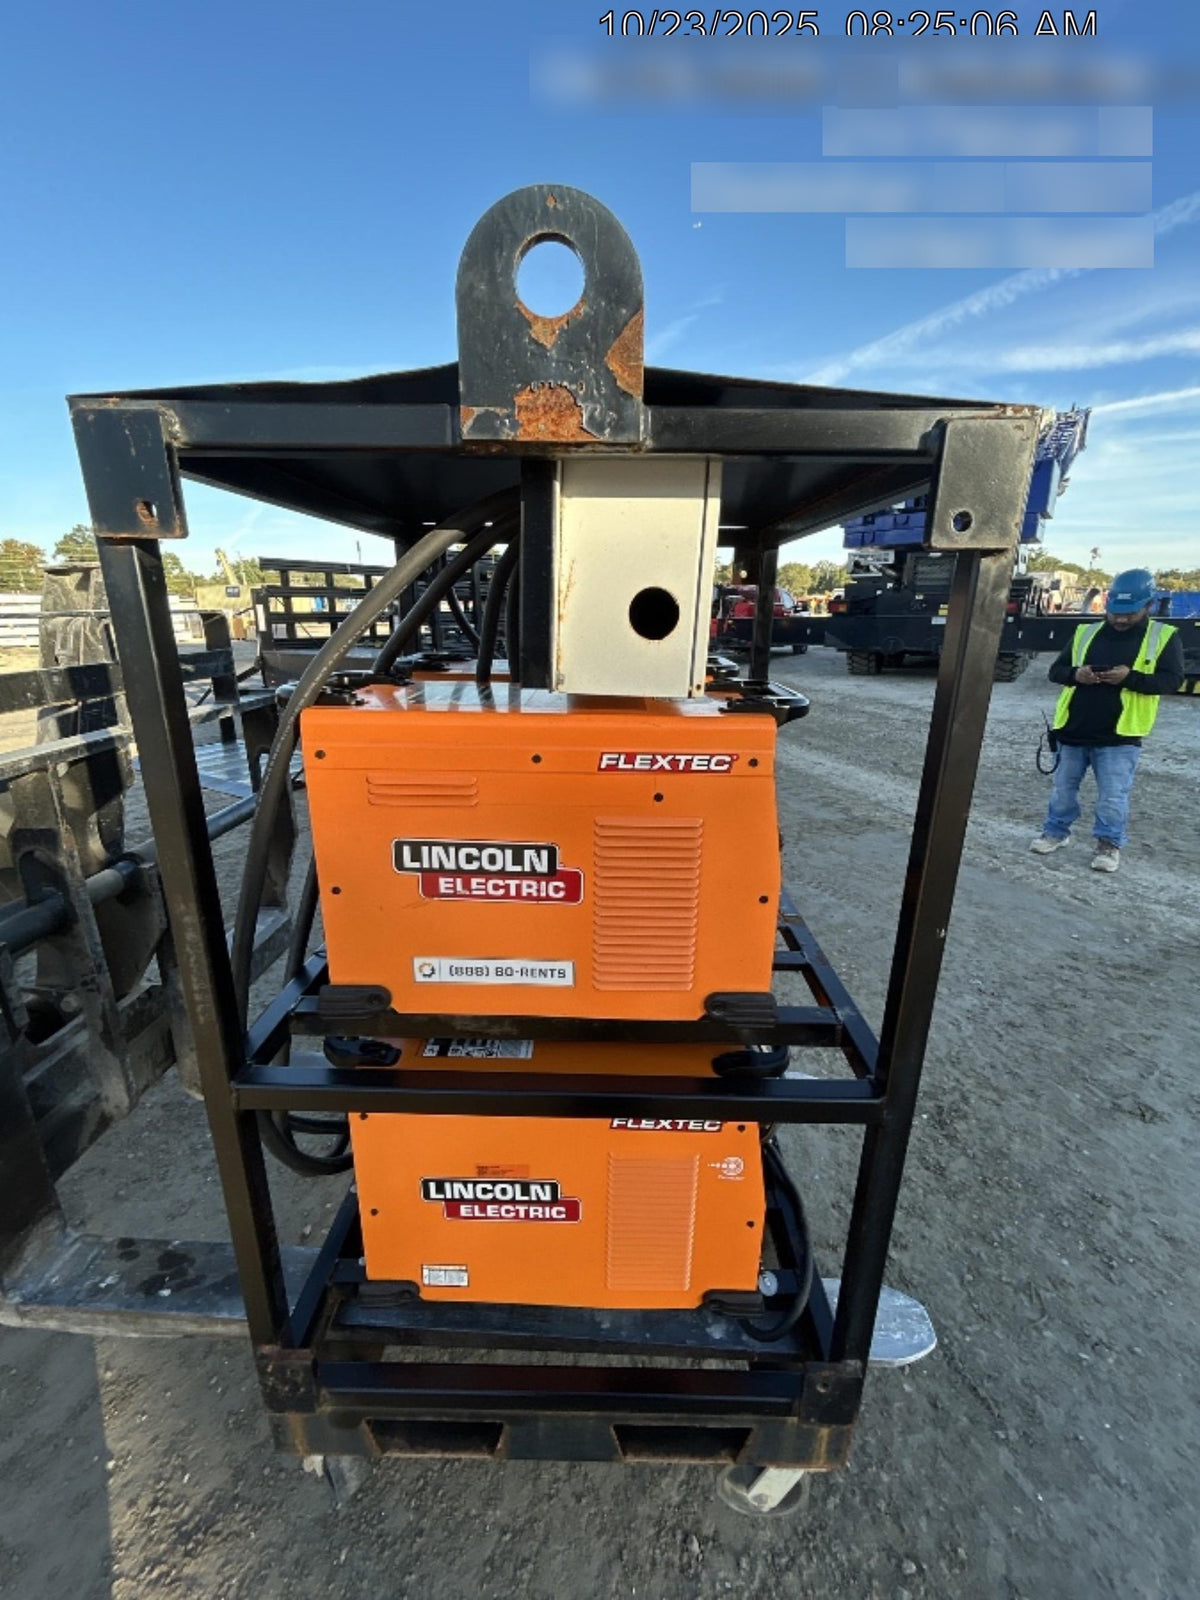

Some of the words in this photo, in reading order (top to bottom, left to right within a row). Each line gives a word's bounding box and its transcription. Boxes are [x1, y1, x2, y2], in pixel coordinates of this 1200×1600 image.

[600, 753, 732, 771] FLEXTEC
[402, 845, 549, 874] LINCOLN
[438, 876, 567, 899] ELECTRIC
[449, 964, 490, 977] (888)
[611, 1117, 721, 1132] FLEXTEC
[428, 1181, 552, 1201] LINCOLN
[459, 1204, 567, 1219] ELECTRIC
